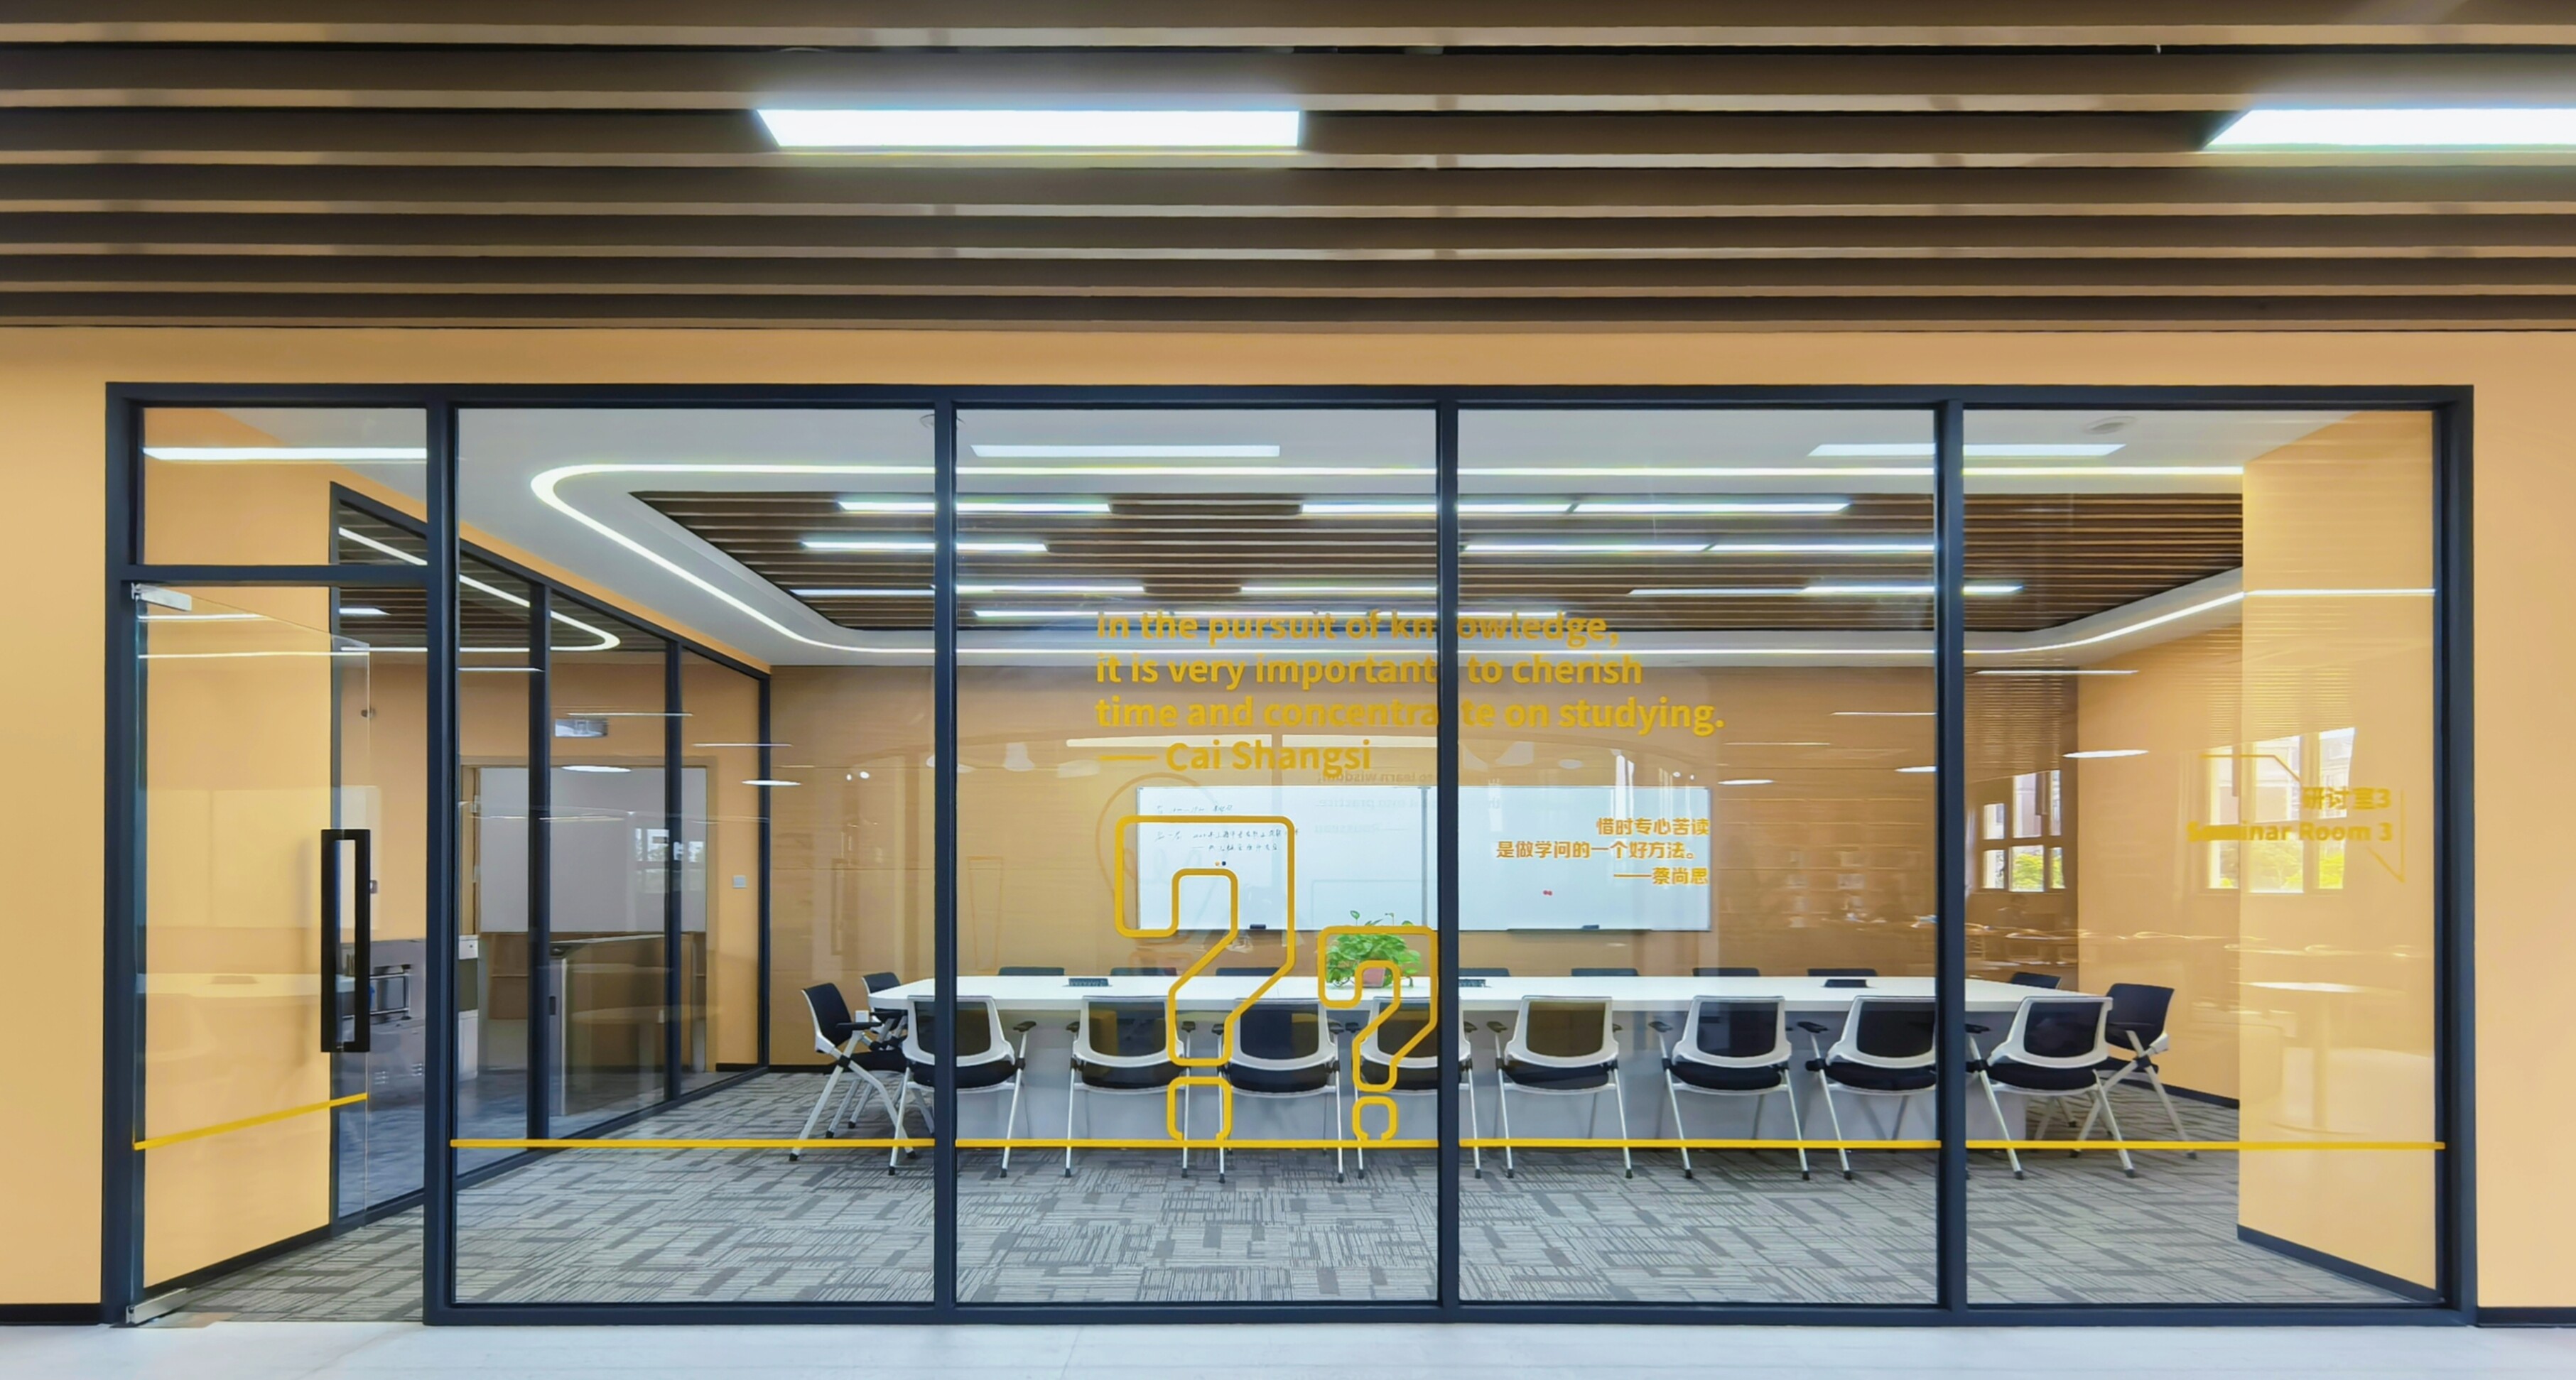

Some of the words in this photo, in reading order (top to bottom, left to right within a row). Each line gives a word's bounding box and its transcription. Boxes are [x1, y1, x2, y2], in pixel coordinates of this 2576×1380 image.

[1098, 612, 1130, 639] In
[1140, 609, 1198, 639] the
[1208, 609, 1336, 647] pursuit
[1345, 609, 1381, 639] of
[1096, 654, 1123, 684] it
[1130, 654, 1159, 684] is
[1167, 661, 1246, 691] very
[1255, 654, 1439, 691] important
[1467, 656, 1504, 685] to
[1511, 653, 1643, 685] cherish
[1095, 695, 1179, 728] time
[1186, 695, 1254, 728] and
[1504, 703, 1550, 728] on
[1558, 695, 1726, 739] studying.
[1165, 739, 1222, 772] Cai
[1231, 739, 1372, 778] Shangsi
[1596, 817, 1710, 836] 惜时专心苦读
[2298, 821, 2372, 842] Room
[2379, 821, 2394, 842] 3
[1496, 840, 1695, 859] 是做学问的一个好方法。
